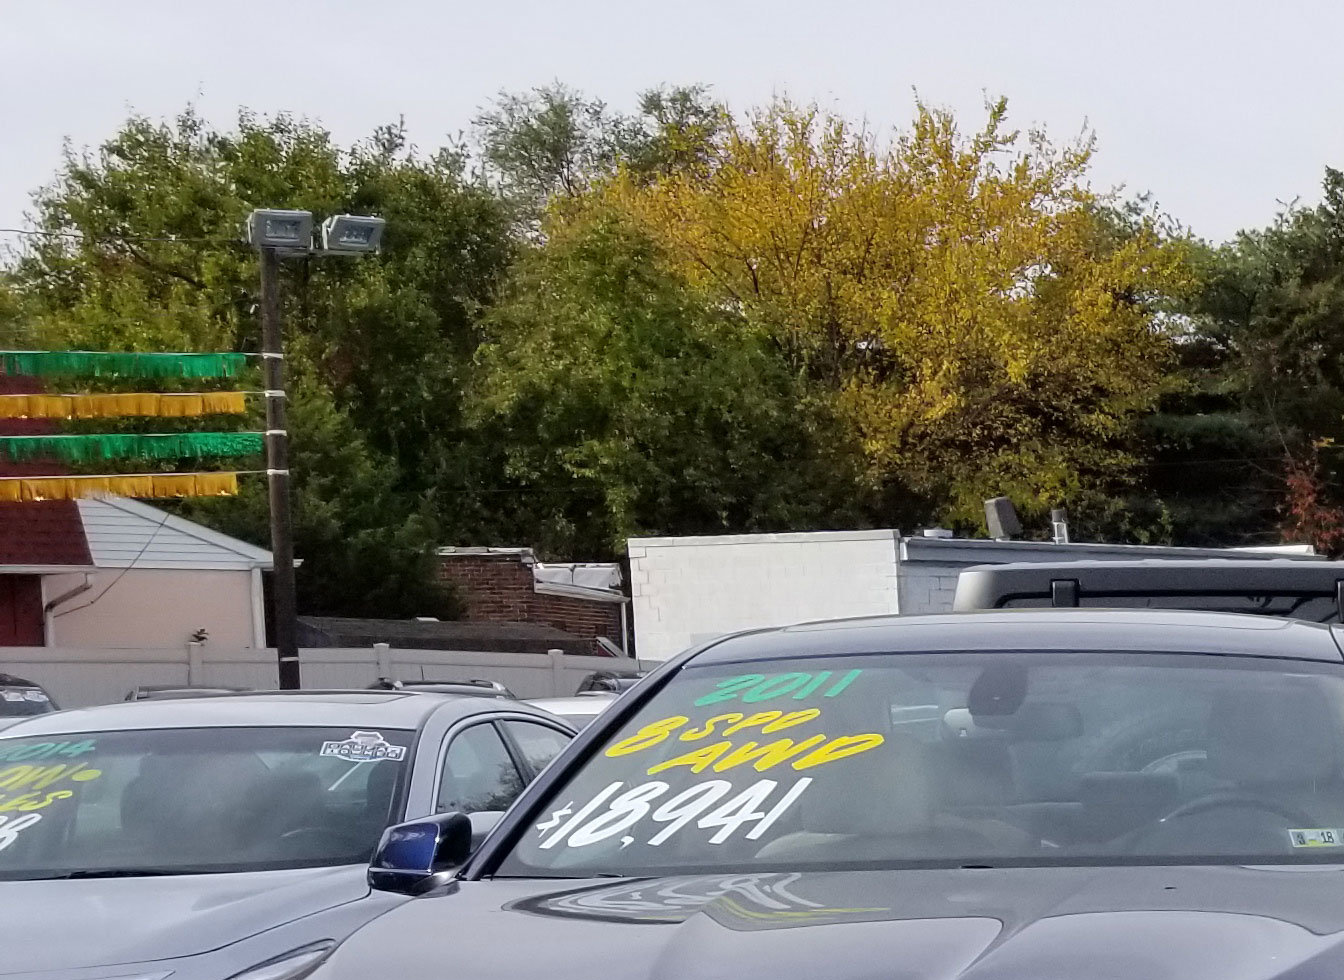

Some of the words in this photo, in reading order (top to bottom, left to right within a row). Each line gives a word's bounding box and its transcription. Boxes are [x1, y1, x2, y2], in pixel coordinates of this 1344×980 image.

[694, 669, 863, 706] 2011
[605, 716, 689, 757] 8
[679, 708, 821, 742] SPD
[647, 733, 885, 775] AWD
[535, 777, 814, 851] $18,941
